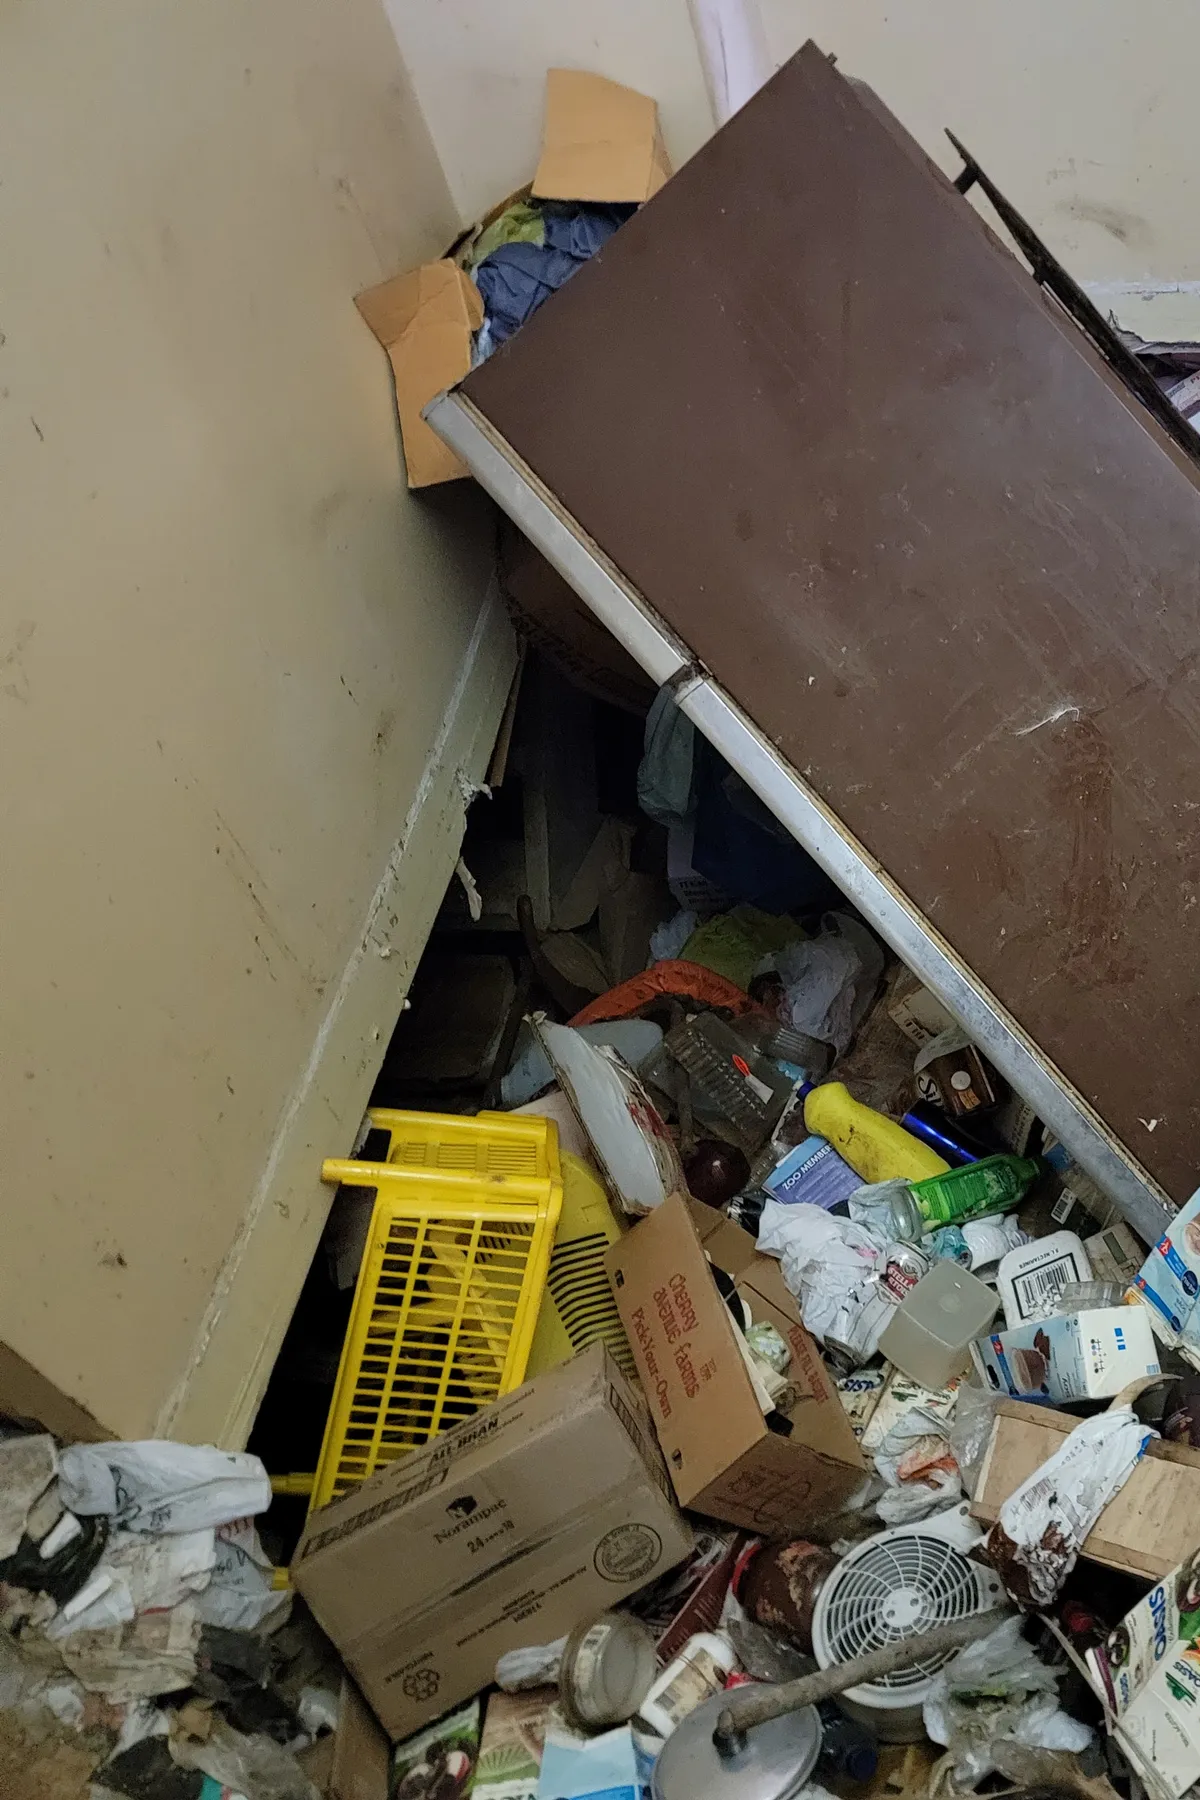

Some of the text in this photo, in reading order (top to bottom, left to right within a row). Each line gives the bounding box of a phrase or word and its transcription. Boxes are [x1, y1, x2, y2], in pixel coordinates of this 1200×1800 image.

[918, 1075, 942, 1103] Sil
[781, 1144, 833, 1191] ZOO MEMBER
[631, 1307, 672, 1420] Pick-Your-Own
[1149, 1586, 1168, 1661] OASIS
